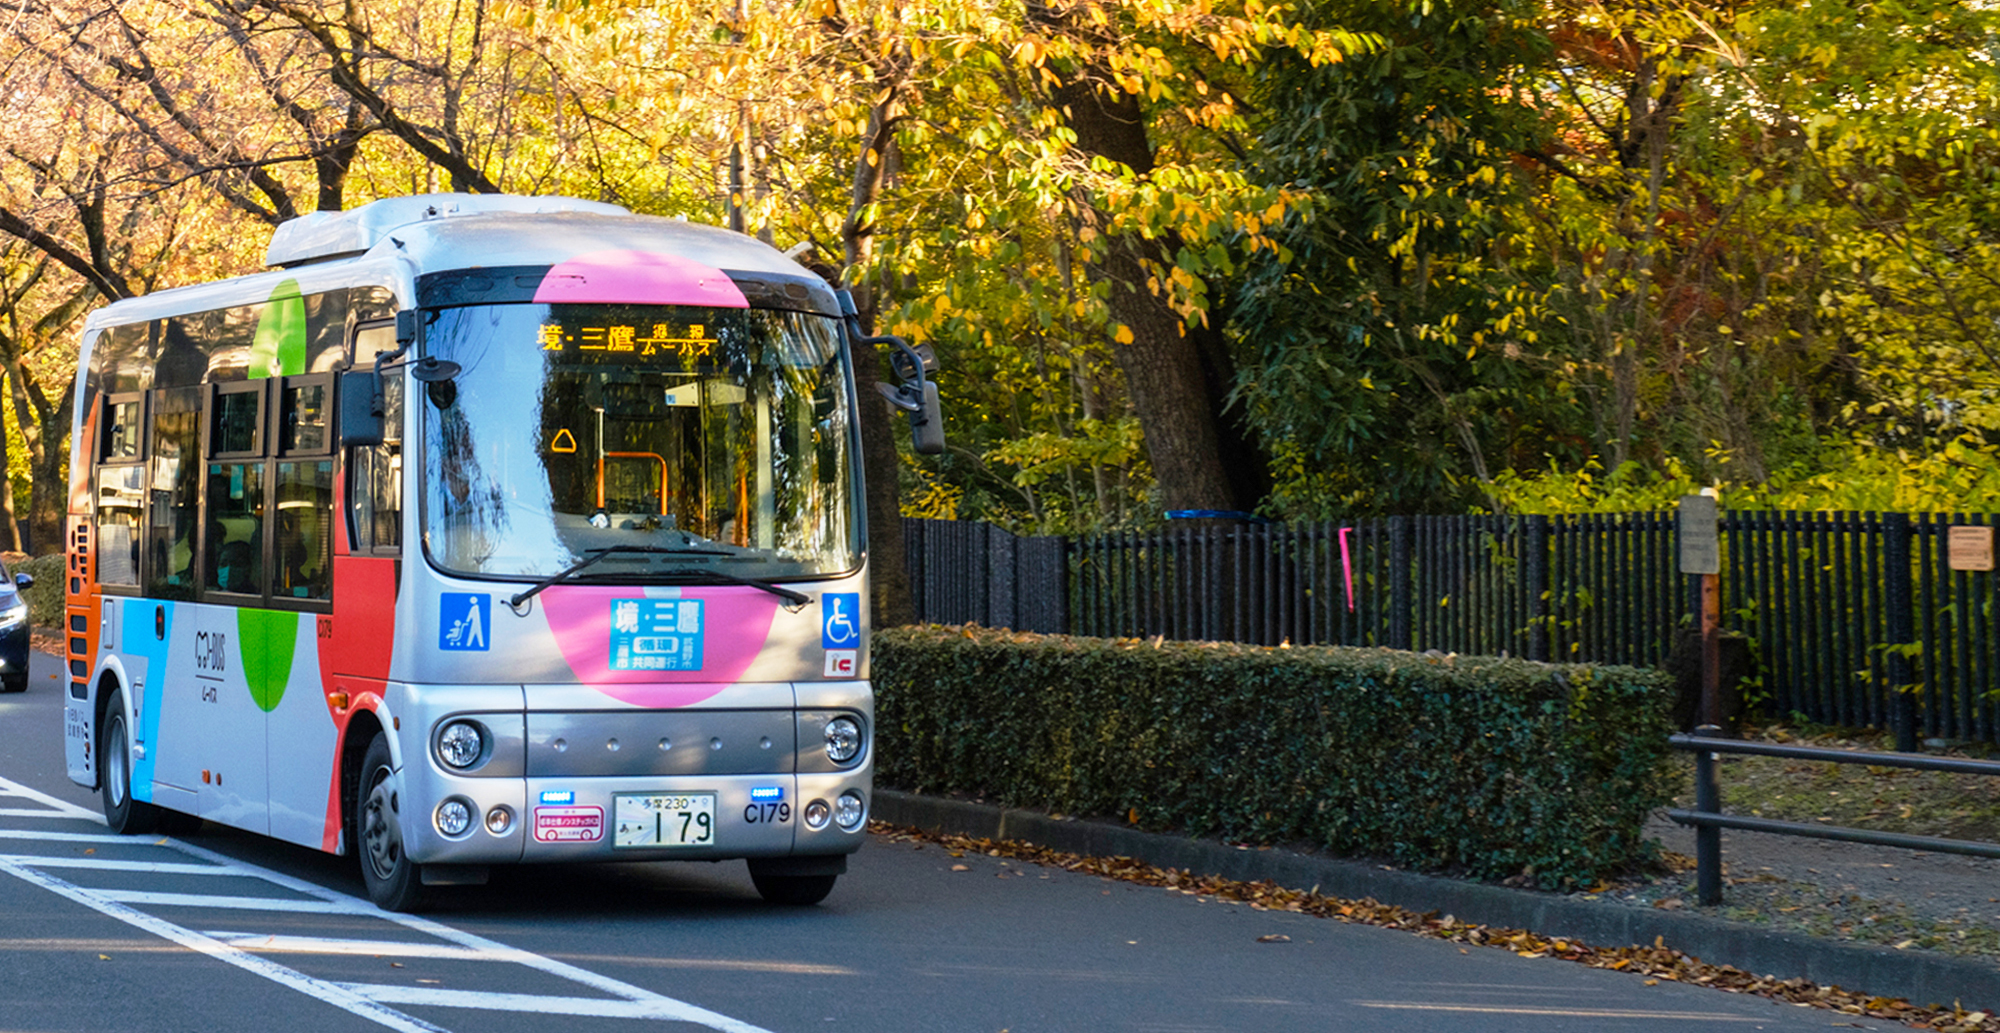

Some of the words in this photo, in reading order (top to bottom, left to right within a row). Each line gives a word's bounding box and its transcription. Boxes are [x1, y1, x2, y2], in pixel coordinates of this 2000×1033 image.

[641, 342, 710, 356] ムーバス
[744, 802, 791, 823] C179
